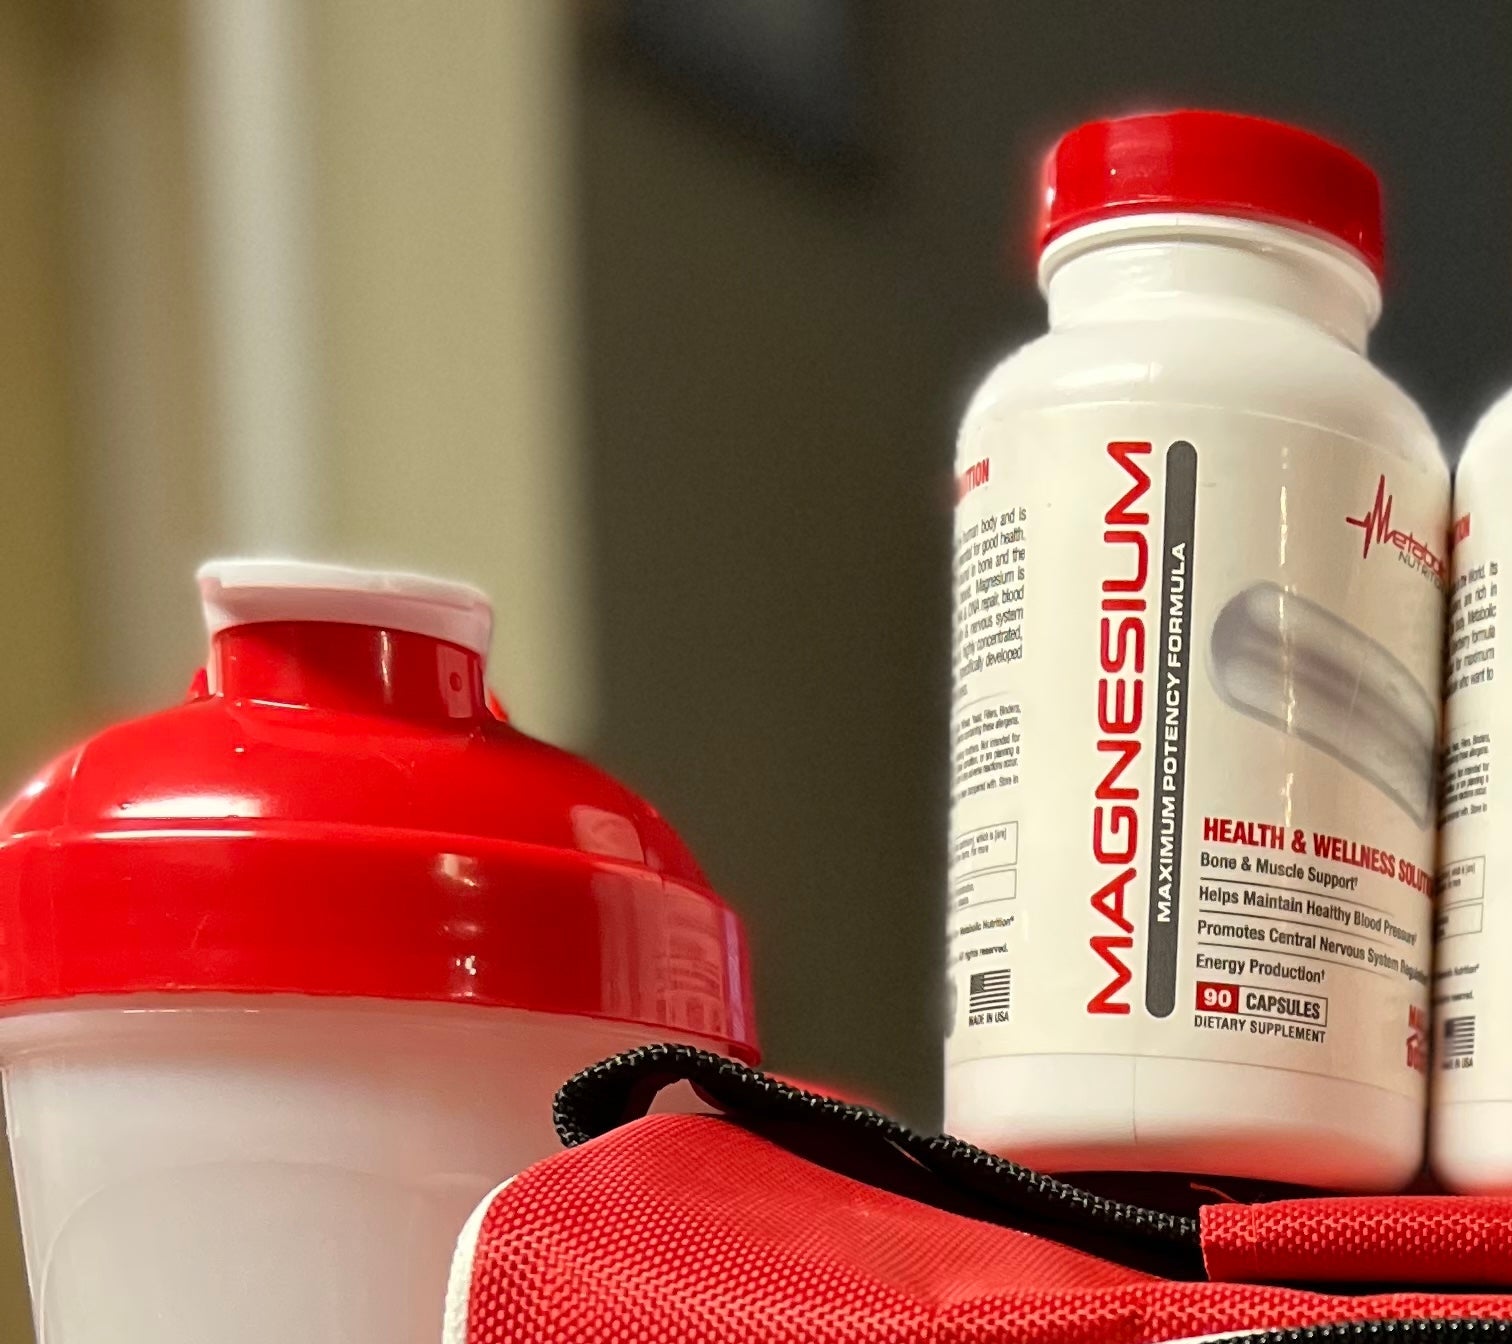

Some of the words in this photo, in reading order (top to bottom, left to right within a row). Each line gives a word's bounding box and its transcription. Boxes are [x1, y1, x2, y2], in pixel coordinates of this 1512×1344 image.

[1167, 542, 1187, 668] FORMULA
[1087, 441, 1152, 1015] MAGNESIUM
[1162, 672, 1181, 792] POTENCY
[1156, 796, 1177, 923] MAXIMUM
[1200, 851, 1237, 870] Bone
[1240, 856, 1252, 872] &
[1256, 858, 1304, 880] Muscle
[1203, 817, 1285, 850] HEALTH
[1291, 829, 1307, 855] &
[1313, 832, 1396, 879] WELLNESS
[1199, 885, 1239, 906] Helps
[1243, 890, 1302, 914] Maintain
[1306, 899, 1351, 926] Healthy
[1353, 910, 1382, 932] Blood
[1196, 952, 1246, 976] Energy
[1197, 919, 1266, 942] Promotes
[1269, 927, 1316, 950] Central
[1319, 937, 1366, 961] Nervous
[1367, 948, 1399, 972] System
[1194, 1014, 1246, 1033] DIETARY
[1250, 1020, 1326, 1044] SUPPLEMENT
[1203, 987, 1232, 1009] 90
[1245, 993, 1321, 1021] CAPSULES
